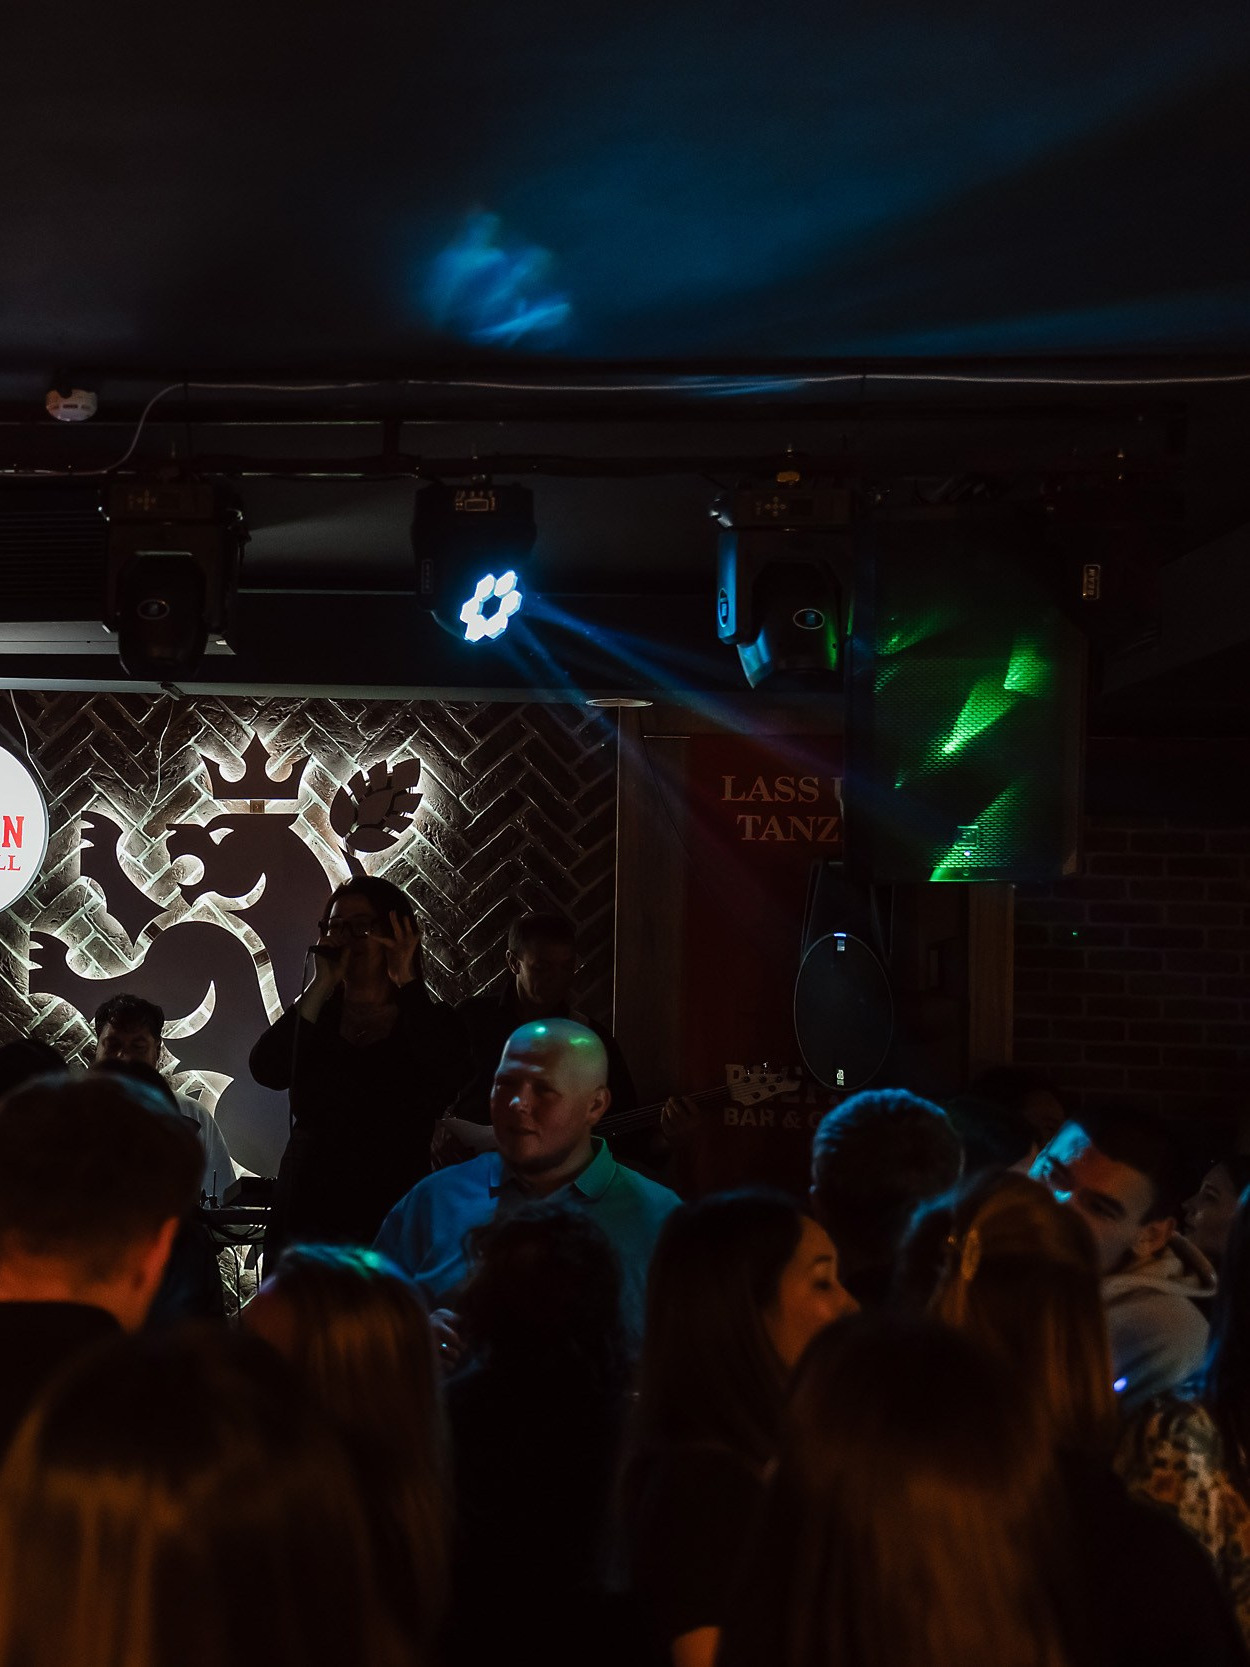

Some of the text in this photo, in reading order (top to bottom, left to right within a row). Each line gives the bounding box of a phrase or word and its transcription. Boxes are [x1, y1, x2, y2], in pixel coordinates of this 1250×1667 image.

[721, 775, 820, 802] LASS
[736, 814, 841, 842] TANZ
[723, 1106, 775, 1128] BAR
[782, 1109, 802, 1129] &
